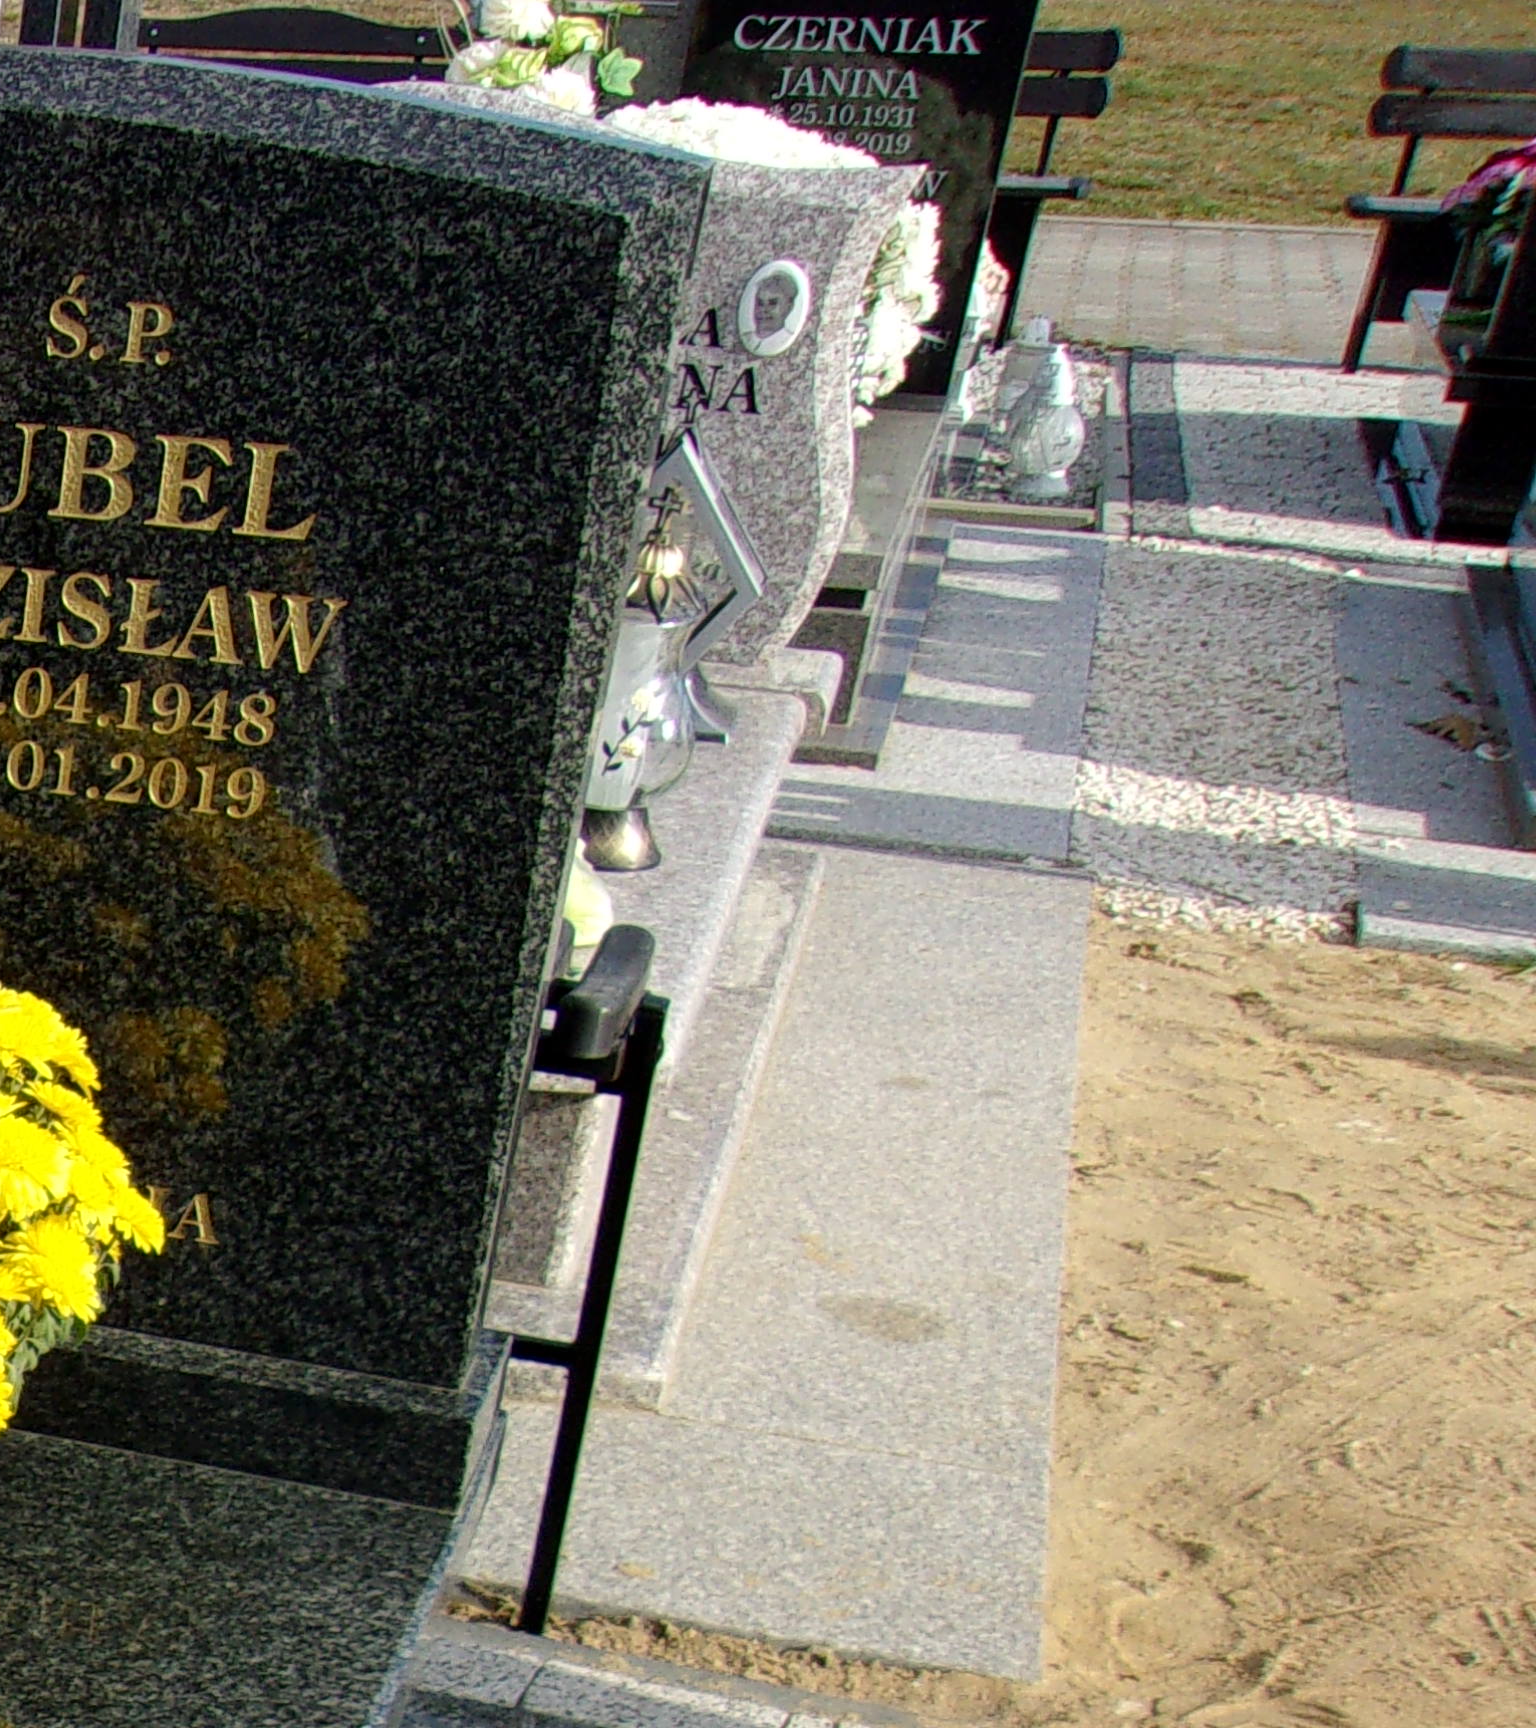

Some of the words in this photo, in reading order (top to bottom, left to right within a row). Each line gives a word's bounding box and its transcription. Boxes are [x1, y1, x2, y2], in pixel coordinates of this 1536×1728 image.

[733, 14, 987, 55] CZERNIAK
[771, 65, 921, 101] JANINA
[788, 102, 917, 129] 25.10.1931
